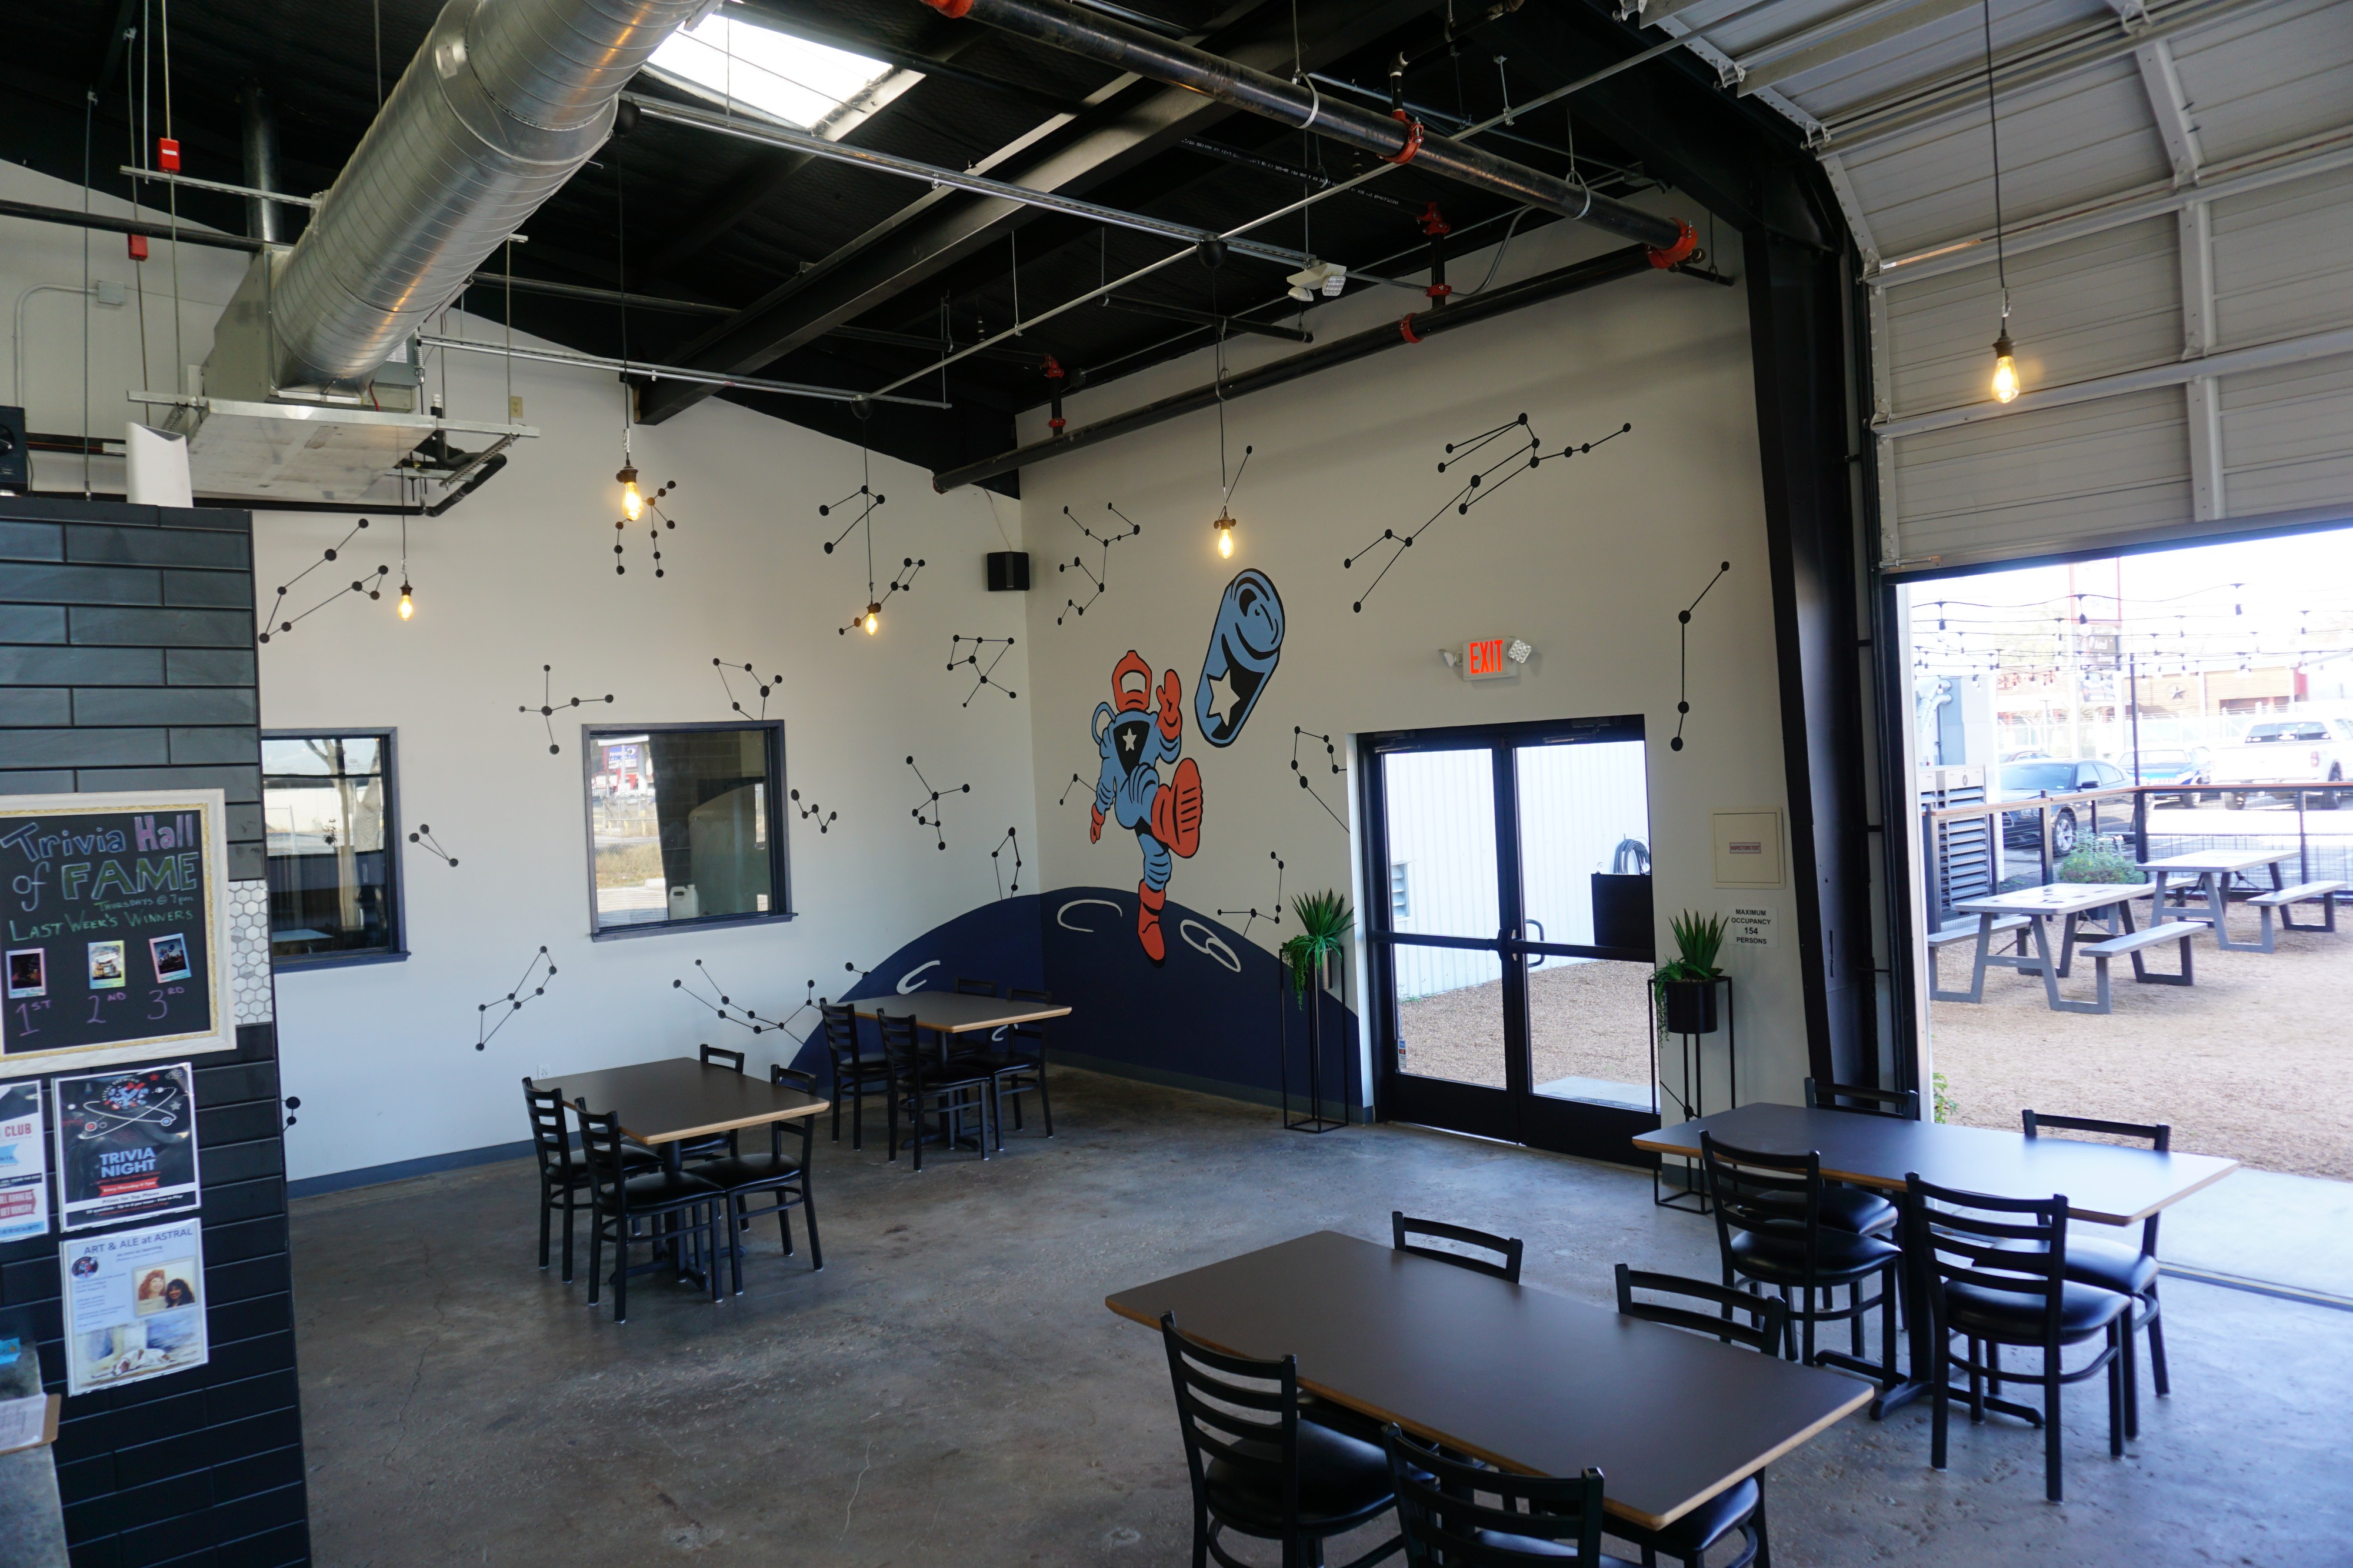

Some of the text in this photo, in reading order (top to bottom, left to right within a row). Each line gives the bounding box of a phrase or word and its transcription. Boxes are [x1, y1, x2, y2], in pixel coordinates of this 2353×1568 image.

[1469, 639, 1504, 674] EXIT
[0, 814, 194, 862] Trivia Hall
[12, 852, 199, 912] of FAME
[156, 896, 168, 905] @
[9, 909, 194, 942] LAST WEEK'S WINNERS
[5, 1123, 32, 1137] CLUB
[99, 1147, 156, 1166] TRIVIA
[101, 1159, 156, 1178] NIGHT
[84, 1244, 105, 1255] ART
[108, 1242, 116, 1250] &
[119, 1238, 139, 1249] ALE
[154, 1228, 193, 1242] ASTRAL
